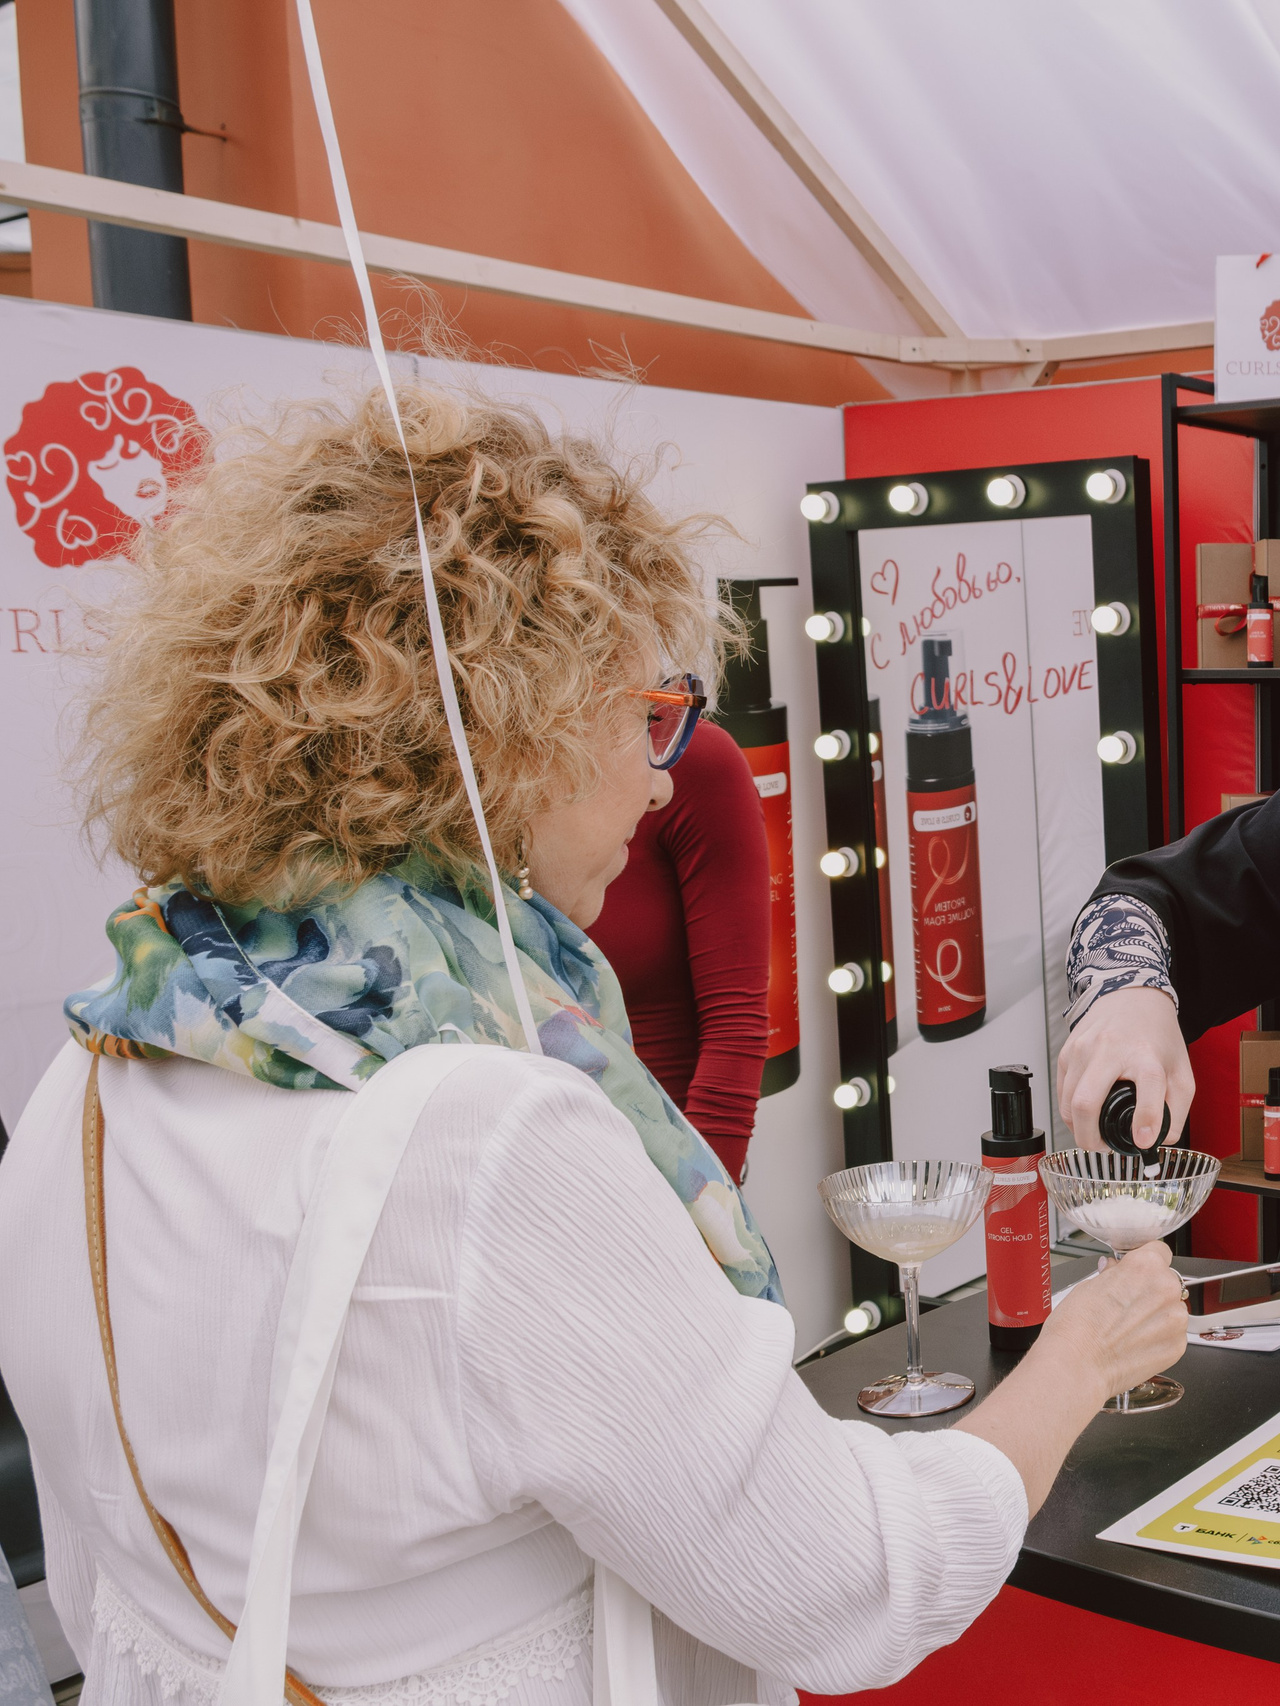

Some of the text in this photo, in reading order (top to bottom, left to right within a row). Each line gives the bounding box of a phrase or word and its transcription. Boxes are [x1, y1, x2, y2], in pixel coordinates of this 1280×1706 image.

[870, 632, 891, 670] С
[1000, 1227, 1014, 1235] GEL
[987, 1232, 1033, 1243] STRONG HOLD
[1038, 1200, 1051, 1310] DRAMA QUEEN
[1195, 1528, 1237, 1539] БАНК
